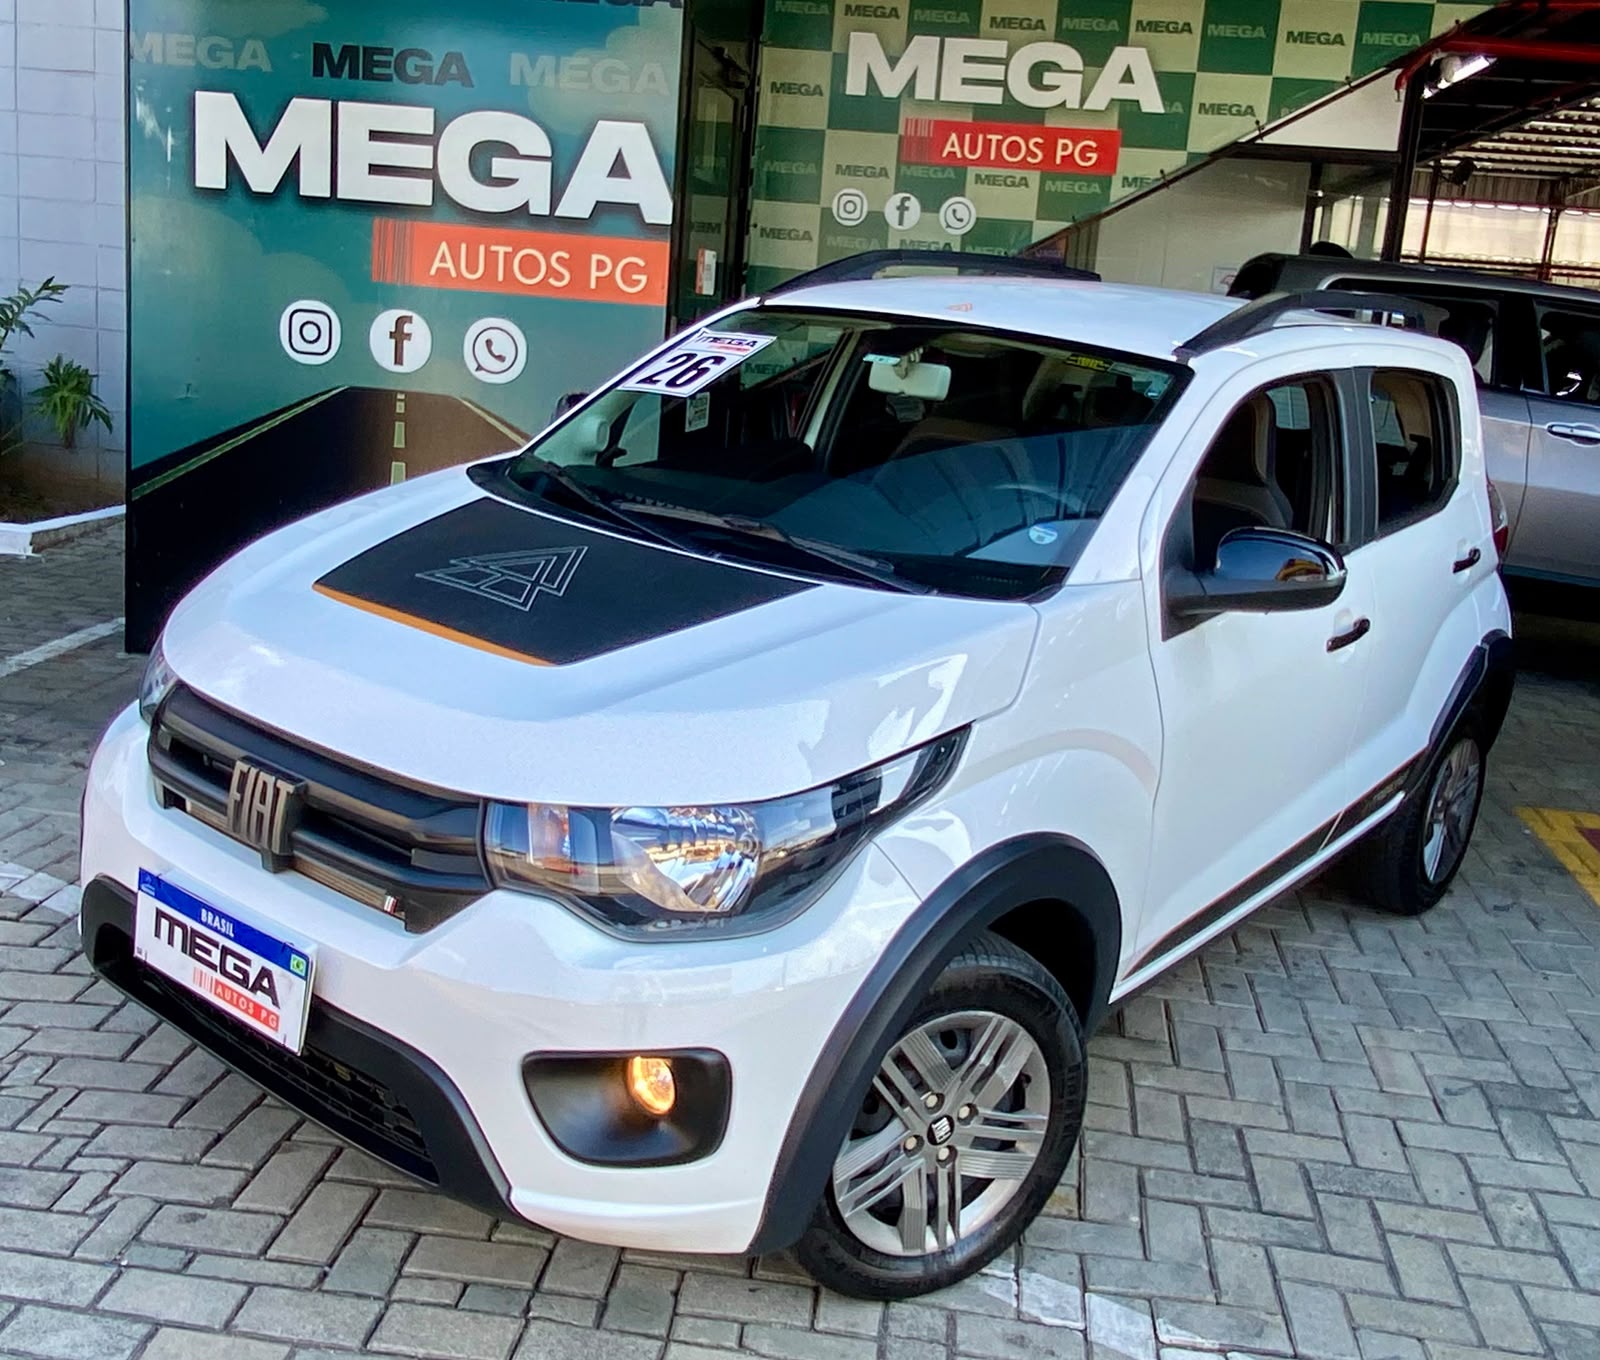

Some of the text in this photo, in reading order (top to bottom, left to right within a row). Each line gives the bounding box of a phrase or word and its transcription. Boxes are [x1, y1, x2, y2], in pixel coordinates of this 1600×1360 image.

[775, 0, 830, 15] MEGA
[844, 4, 900, 19] MEGA
[914, 9, 970, 24] MEGA
[989, 16, 1046, 31] MEGA
[1061, 18, 1120, 33] MEGA
[1135, 19, 1193, 35] MEGA
[1207, 24, 1267, 39] MEGA
[1285, 31, 1346, 46] MEGA
[1362, 32, 1420, 46] MEGA
[312, 42, 474, 88] MEGA
[845, 31, 1165, 113] MEGA
[510, 52, 671, 96] MEGA
[770, 81, 824, 97] MEGA
[1198, 102, 1256, 117] MEGA
[942, 132, 1099, 167] AUTOS PG
[194, 91, 674, 225] MEGA
[763, 160, 817, 175] MEGA
[835, 164, 890, 179] MEGA
[901, 165, 956, 179] MEGA
[974, 173, 1030, 188] MEGA
[1045, 180, 1101, 194] MEGA
[760, 226, 813, 242] MEGA
[429, 241, 571, 288] AUTOS
[589, 254, 648, 293] PG
[635, 353, 727, 389] 26
[228, 761, 295, 855] FIAT
[201, 907, 235, 939] BRASIL
[154, 906, 281, 1010] MEGA
[216, 984, 278, 1030] AUTOS PG
